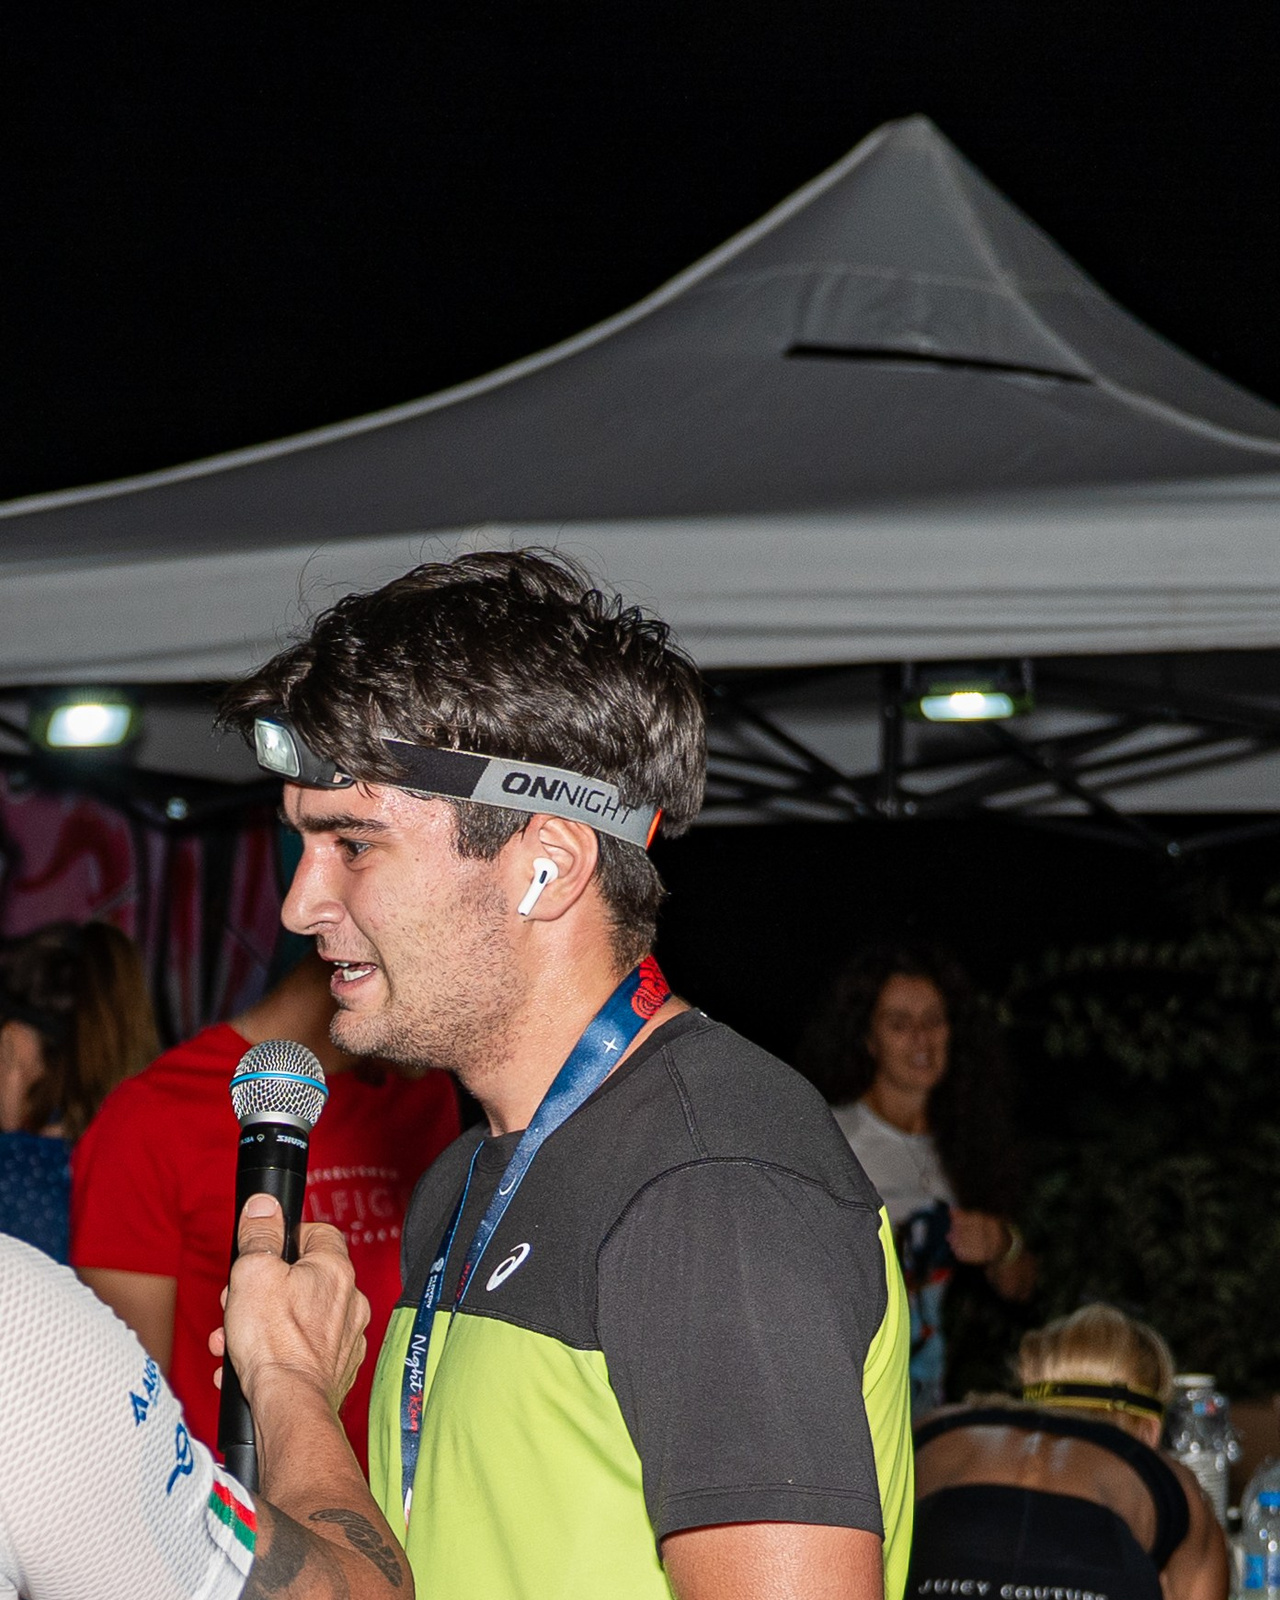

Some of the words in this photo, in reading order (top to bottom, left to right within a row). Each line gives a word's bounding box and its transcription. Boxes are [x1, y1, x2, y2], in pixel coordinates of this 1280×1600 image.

[276, 1134, 308, 1150] SHURE
[404, 1334, 427, 1392] Night
[918, 1578, 991, 1596] JUICY
